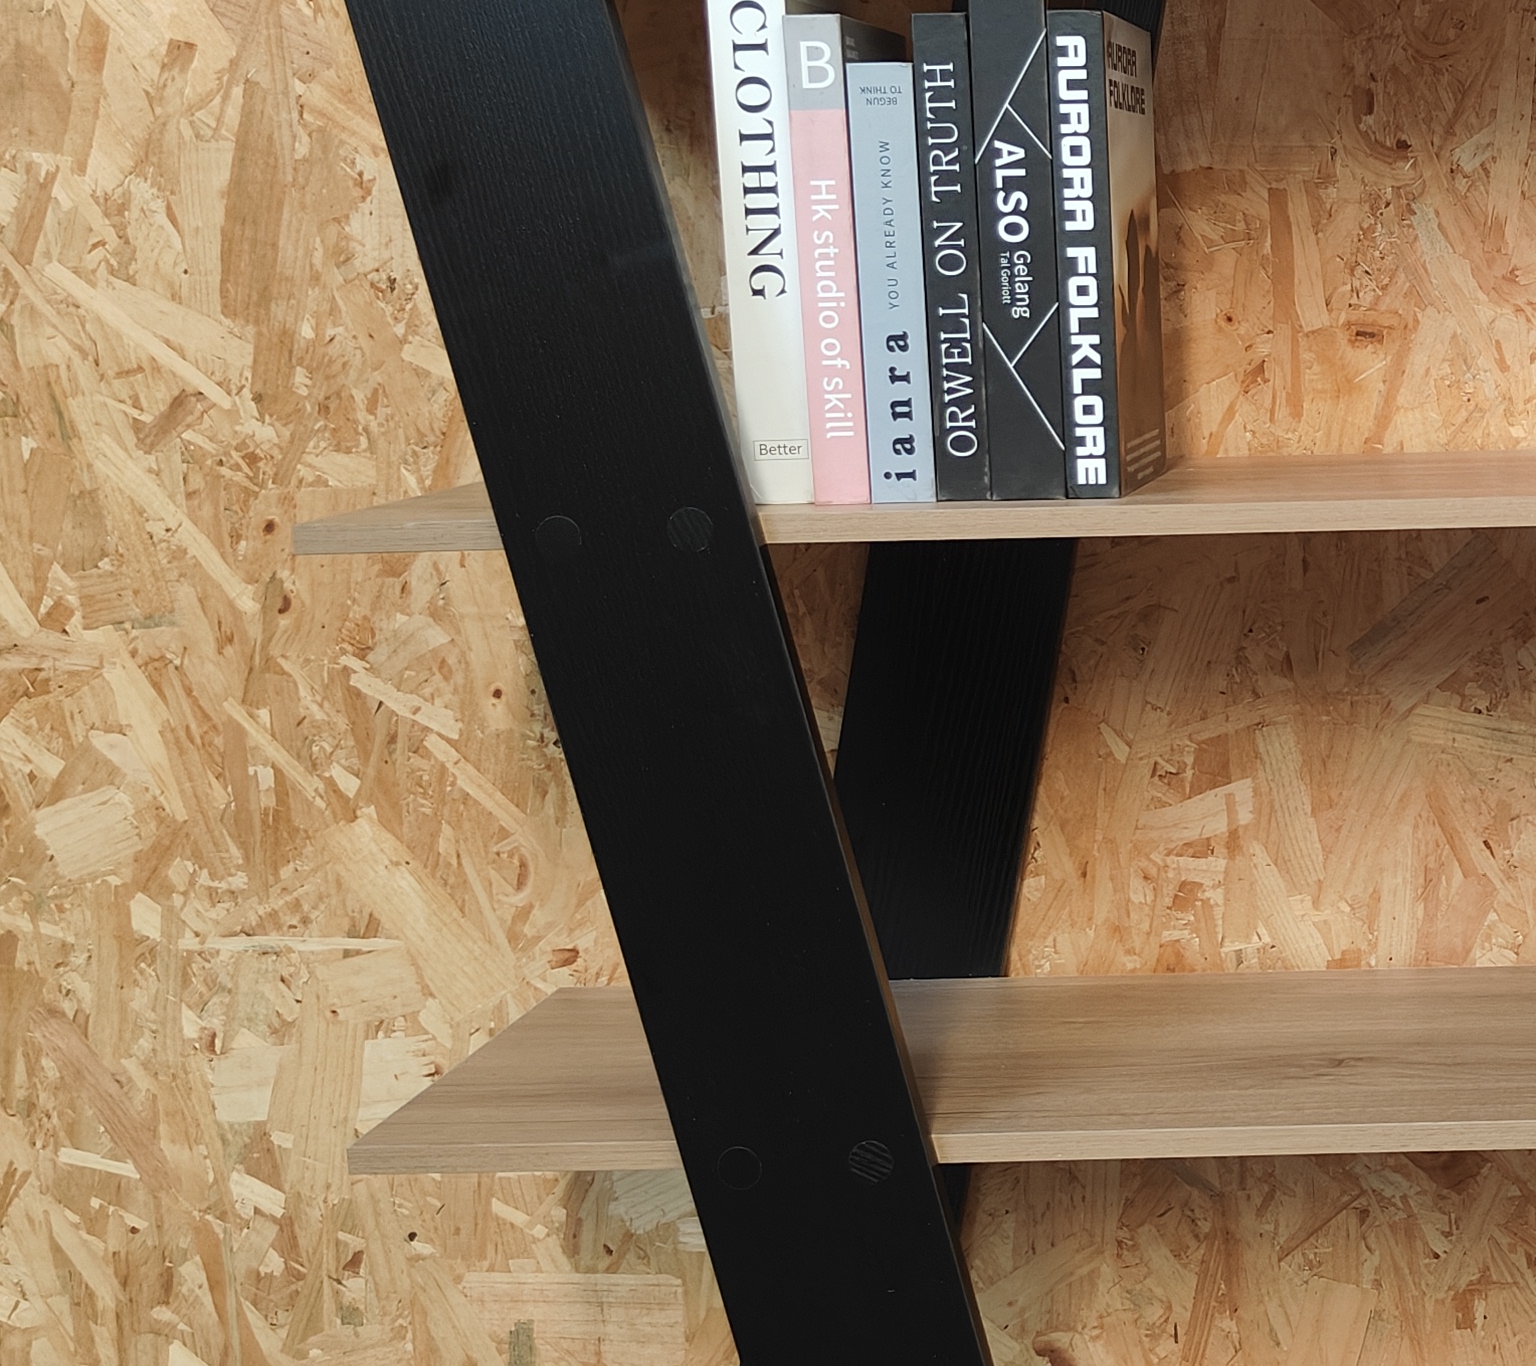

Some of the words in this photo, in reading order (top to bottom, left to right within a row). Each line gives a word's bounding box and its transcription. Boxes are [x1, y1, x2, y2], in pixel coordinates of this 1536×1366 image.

[799, 40, 836, 89] B
[1106, 40, 1138, 78] AURORA
[859, 85, 888, 95] THINK
[865, 96, 898, 106] BEGUN
[889, 85, 903, 95] TO
[1108, 78, 1146, 116] FOLKLORE
[729, 0, 788, 301] CLOTHING
[923, 61, 962, 203] TRUTH
[1055, 35, 1096, 232] AURORA
[878, 140, 893, 188] KNOW
[810, 179, 840, 222] Hk
[993, 139, 1030, 243] ALSO
[882, 197, 898, 270] ALREADY
[933, 220, 967, 277] ON
[812, 229, 846, 329] studio
[1000, 251, 1010, 266] Tal
[888, 278, 900, 311] YOU
[1001, 268, 1012, 305] Goriott
[1012, 250, 1033, 319] Gelang
[820, 338, 851, 370] of
[938, 292, 978, 457] ORWELL
[1066, 246, 1108, 485] FOLKLORE
[822, 376, 855, 439] skill
[758, 442, 803, 457] Better
